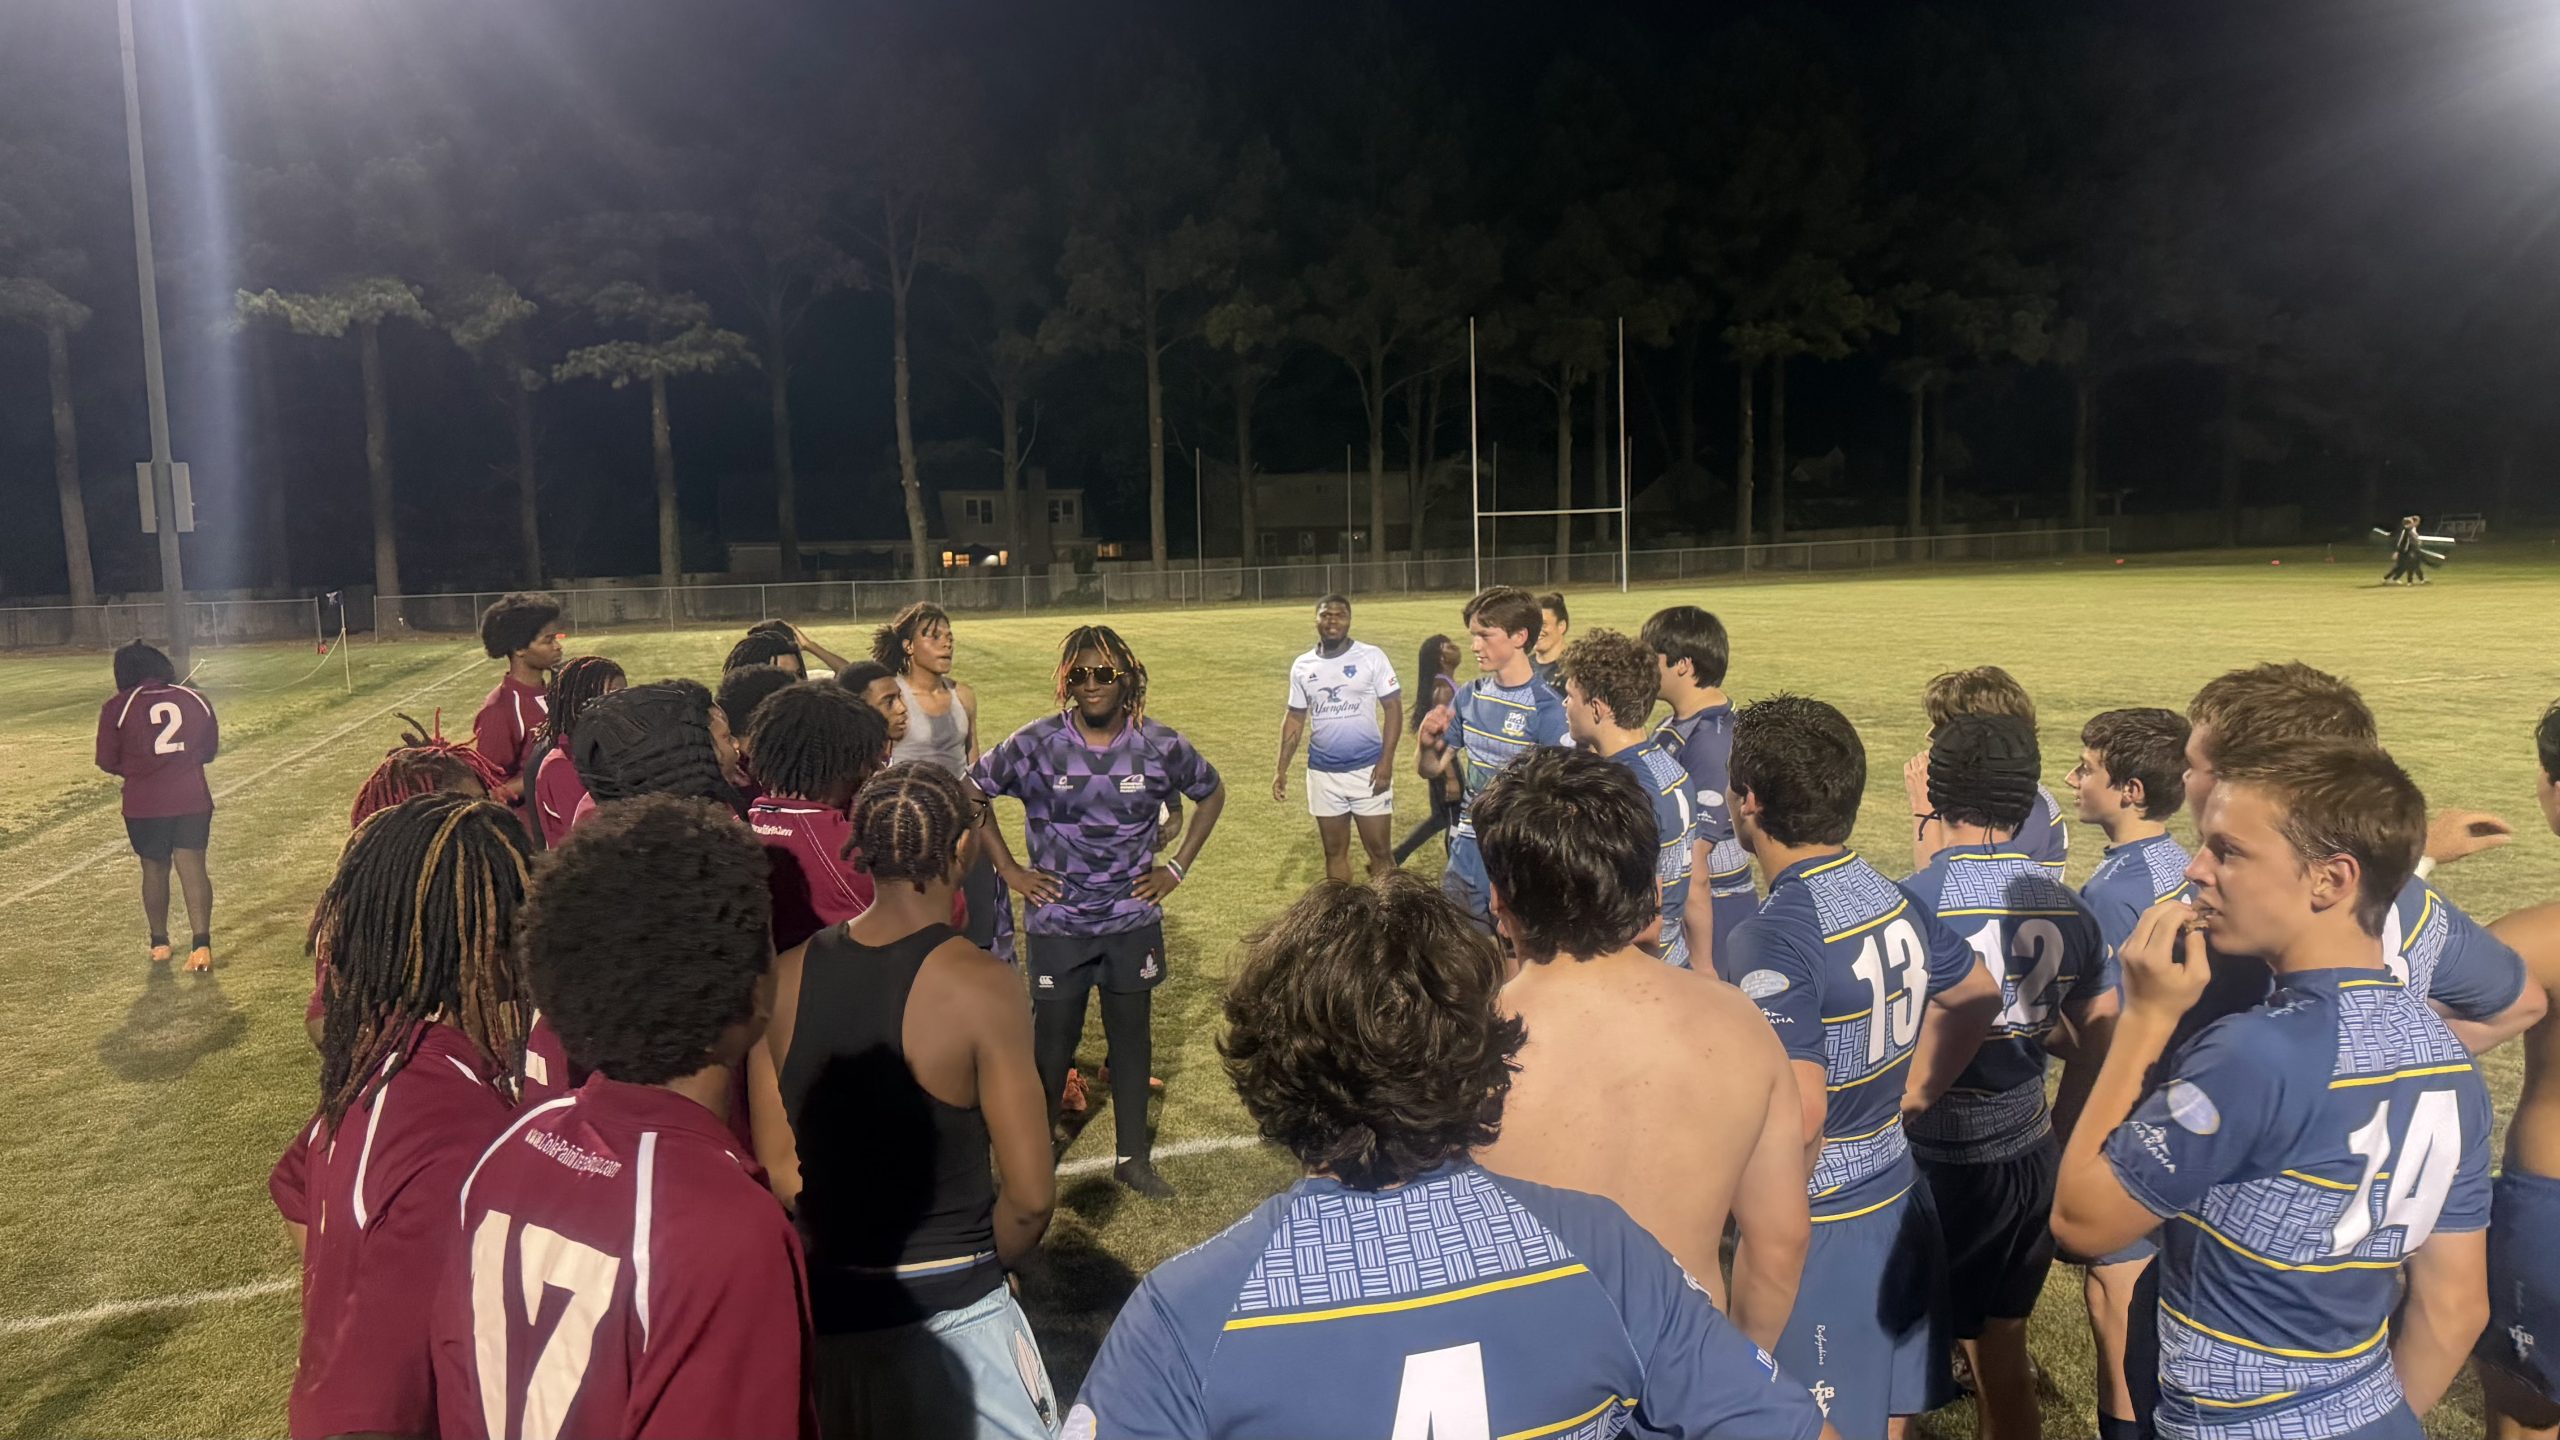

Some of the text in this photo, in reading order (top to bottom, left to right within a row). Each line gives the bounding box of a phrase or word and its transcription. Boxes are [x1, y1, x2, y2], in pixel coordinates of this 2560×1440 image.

[149, 701, 185, 755] 2
[1852, 918, 1929, 1065] 13
[1965, 918, 2065, 1027] 12
[2328, 1089, 2461, 1257] 14
[471, 1209, 621, 1440] 17
